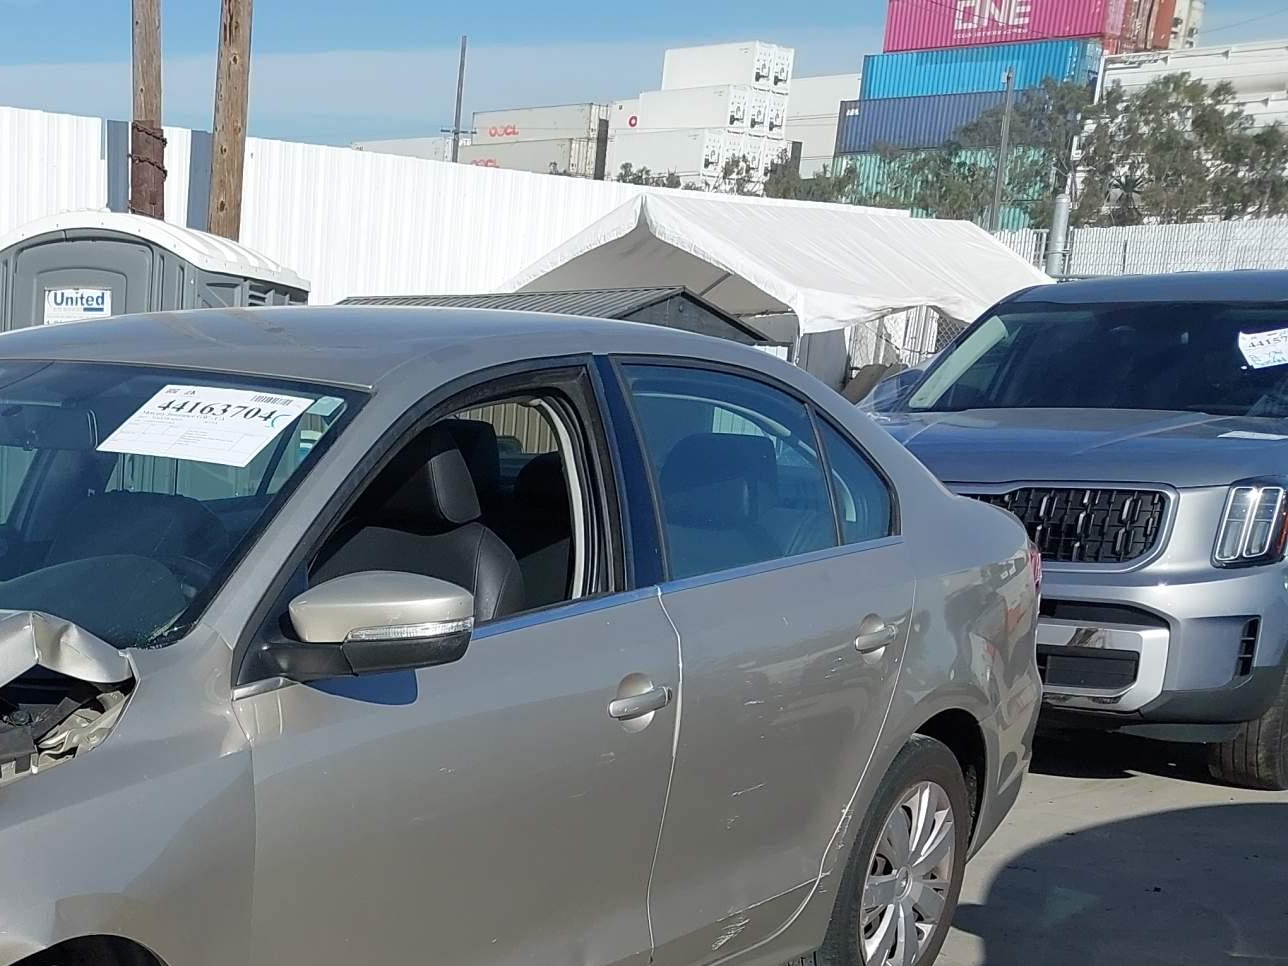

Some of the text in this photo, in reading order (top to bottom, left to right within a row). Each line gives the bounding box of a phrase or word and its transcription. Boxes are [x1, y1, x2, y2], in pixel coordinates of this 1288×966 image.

[954, 0, 1031, 30] ONE
[488, 124, 519, 137] OOCL
[53, 291, 105, 306] United
[158, 399, 277, 422] 44163704
